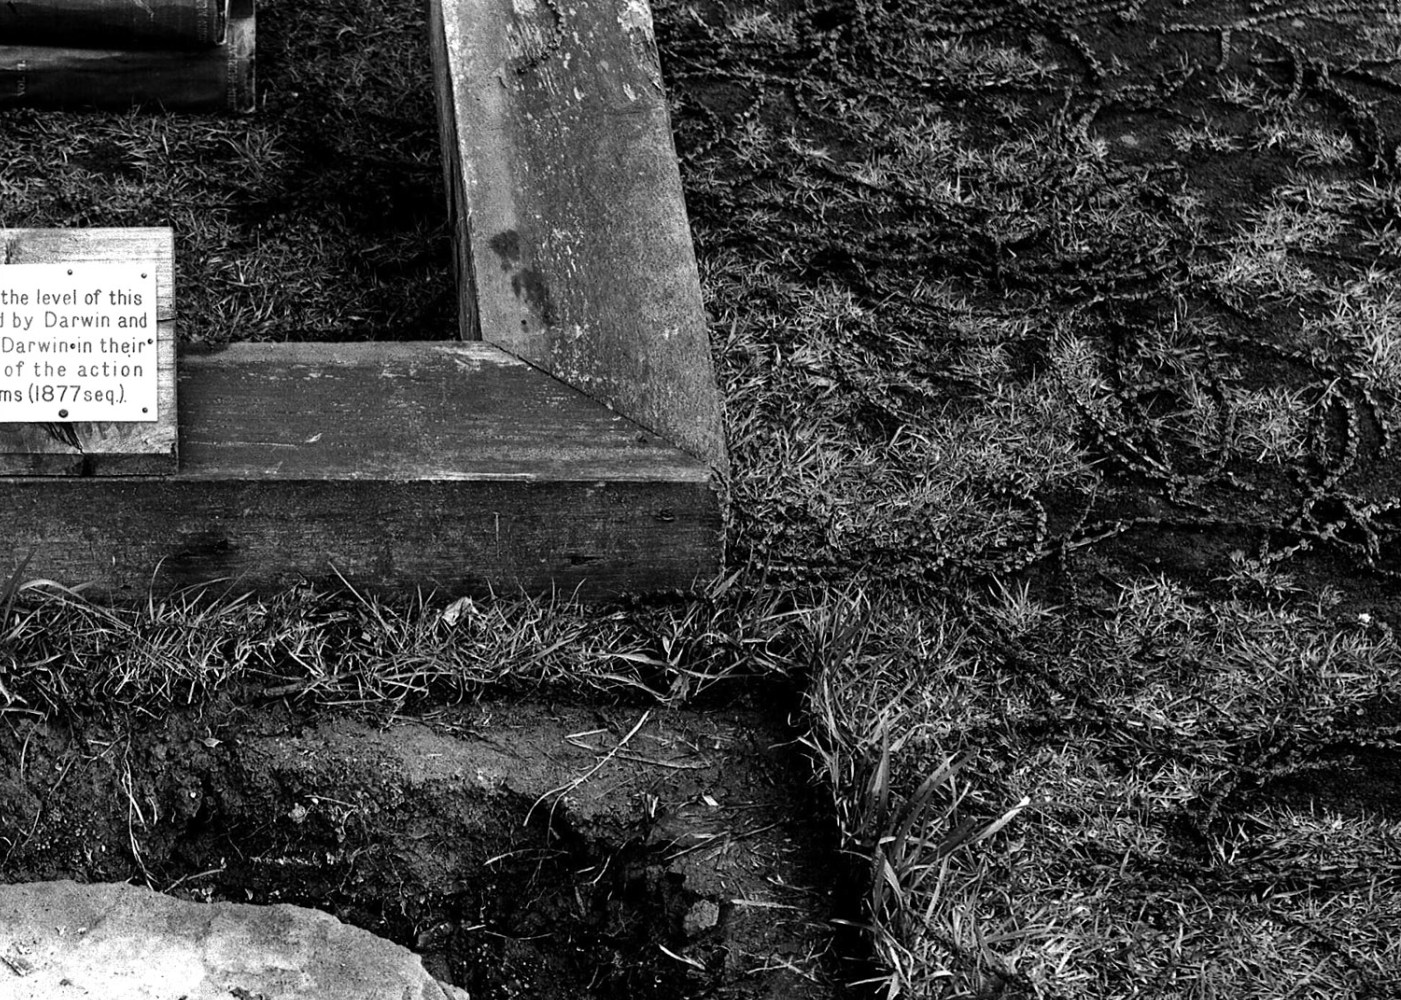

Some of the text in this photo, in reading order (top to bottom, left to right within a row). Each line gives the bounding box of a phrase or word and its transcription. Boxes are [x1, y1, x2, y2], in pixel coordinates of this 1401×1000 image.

[0, 289, 29, 306] the
[36, 288, 77, 306] level
[84, 288, 102, 306] of
[108, 289, 143, 306] this
[12, 312, 33, 332] by
[44, 311, 110, 329] Darwin
[117, 312, 148, 329] and
[1, 336, 68, 354] Darwin
[76, 339, 92, 354] in
[100, 337, 146, 354] their
[4, 360, 25, 378] of
[33, 361, 67, 378] the
[77, 360, 143, 379] action
